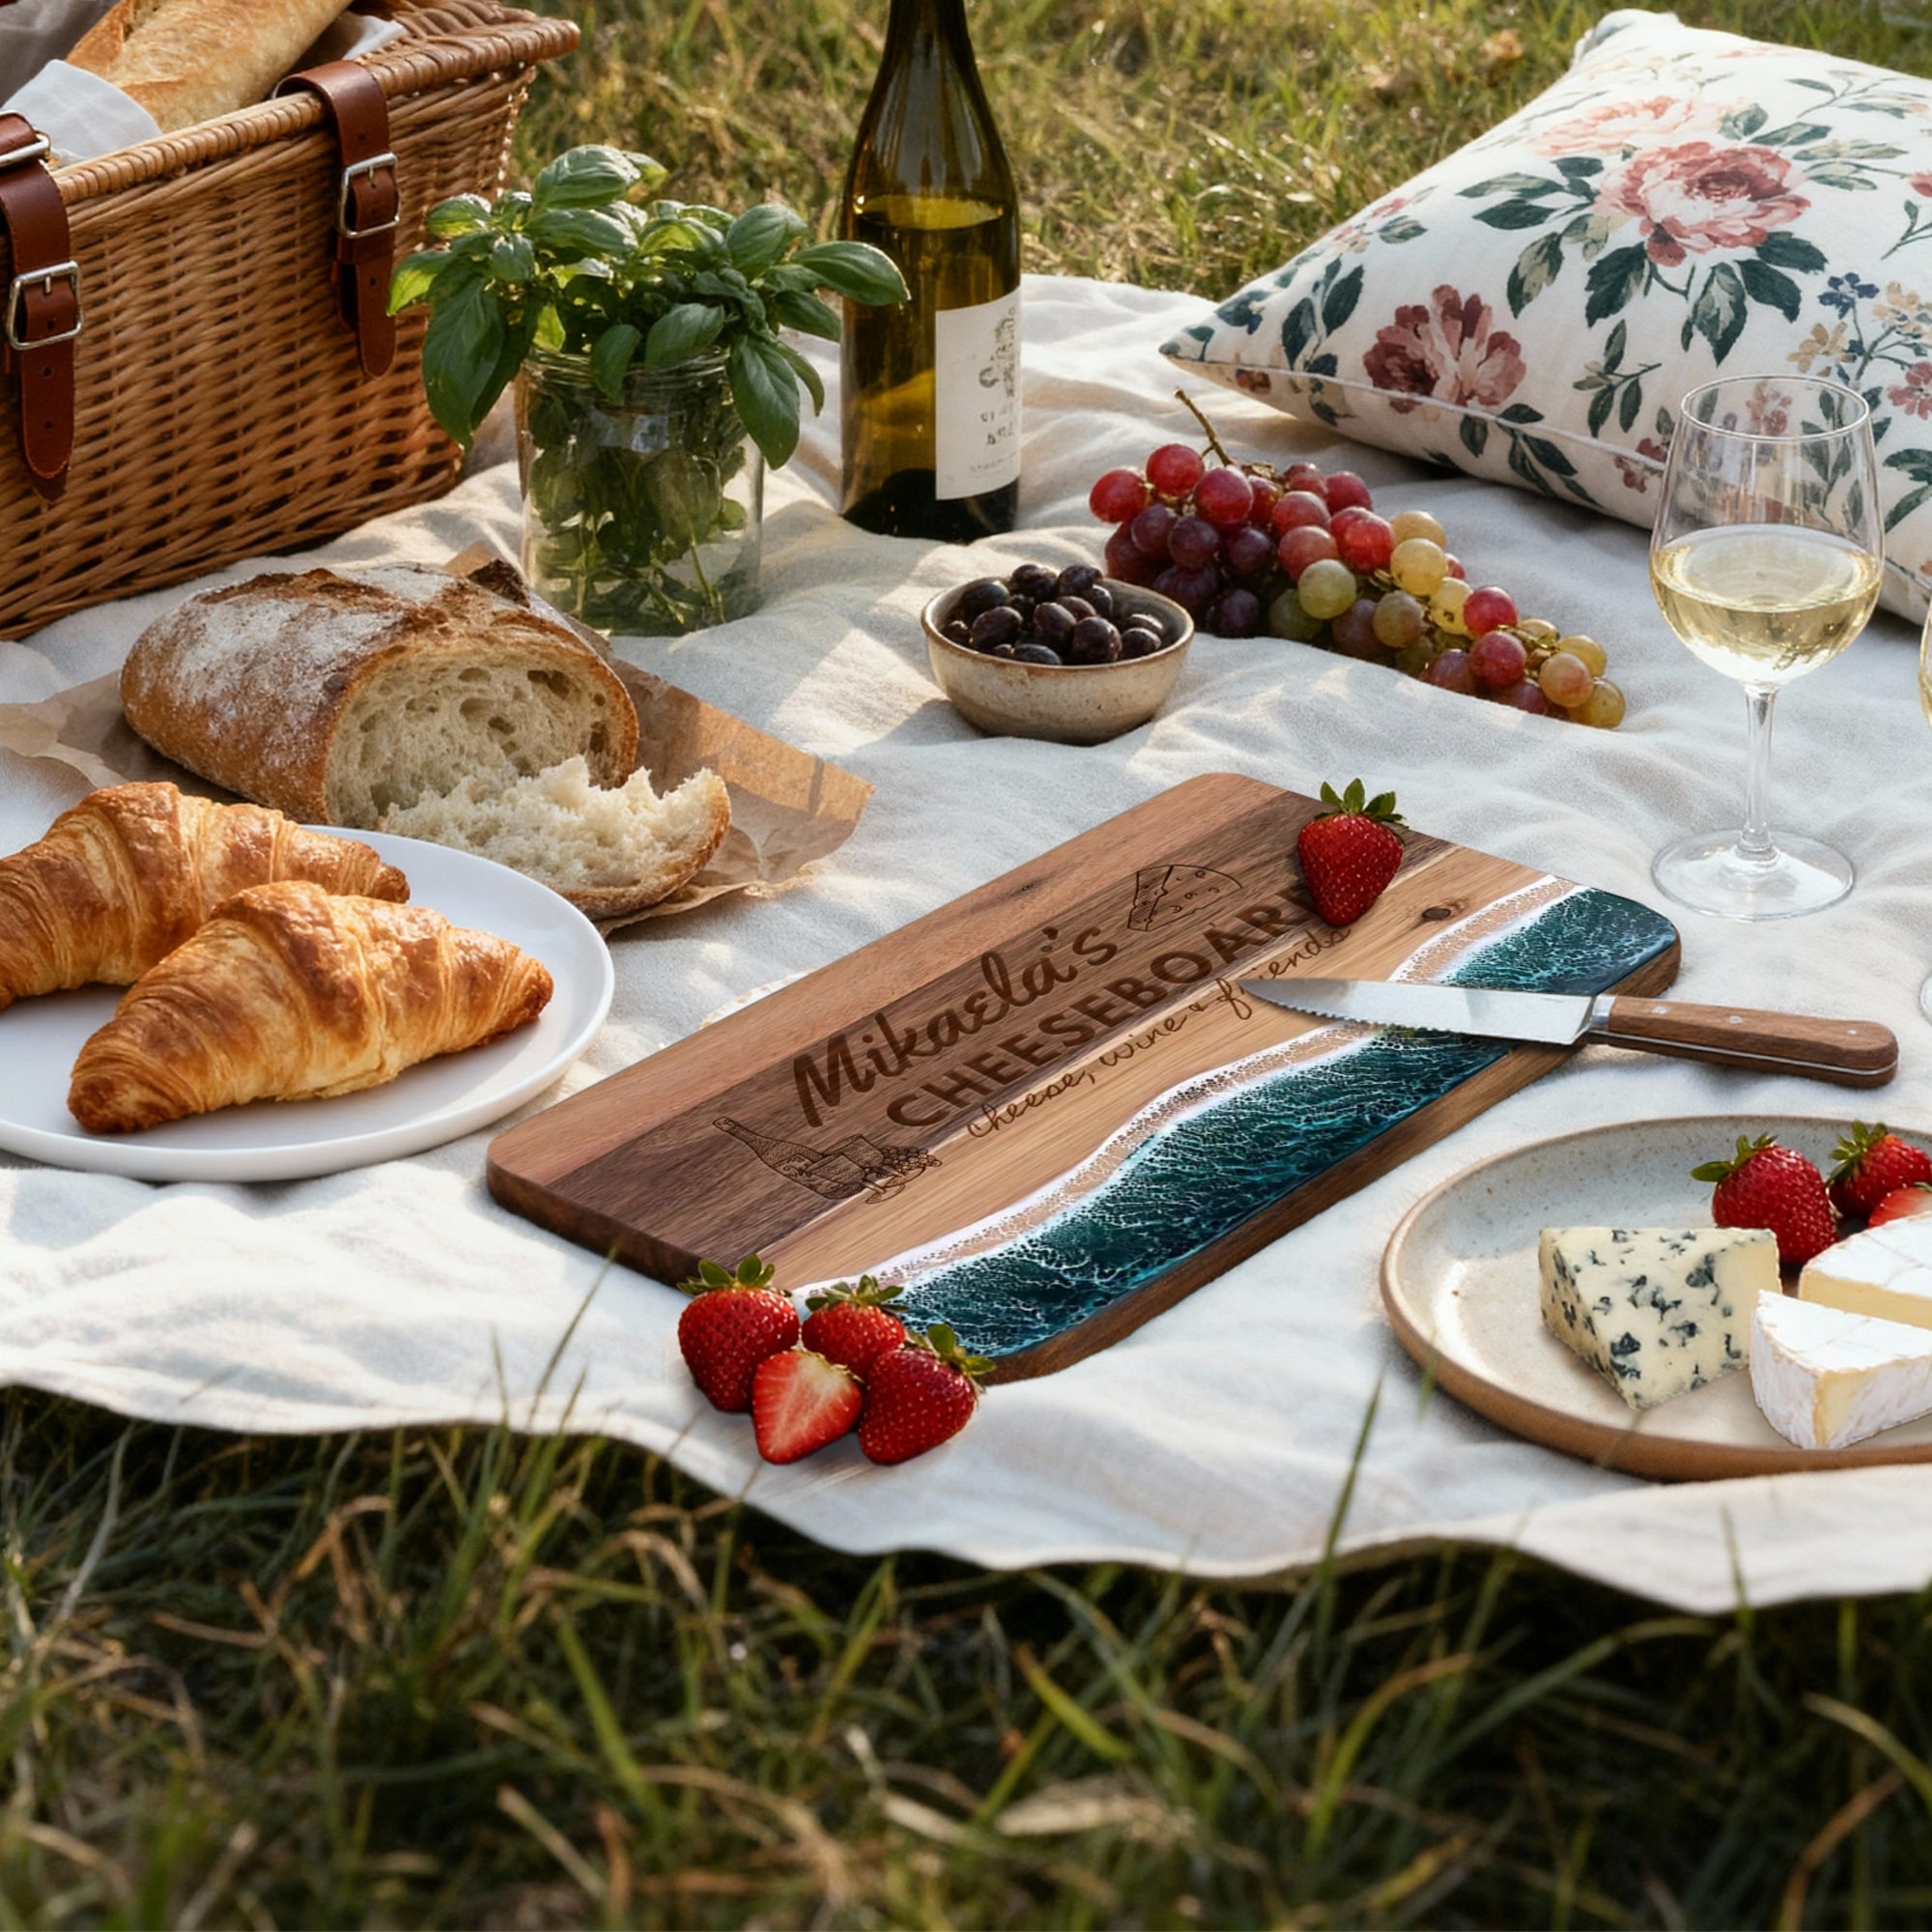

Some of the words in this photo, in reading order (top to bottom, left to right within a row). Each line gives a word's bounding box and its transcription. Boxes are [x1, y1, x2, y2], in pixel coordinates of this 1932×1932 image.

[792, 925, 1118, 1129] Mikaela's
[966, 1068, 1095, 1139] cheese,
[1099, 1013, 1188, 1067] wine
[1216, 927, 1352, 1021] fends
